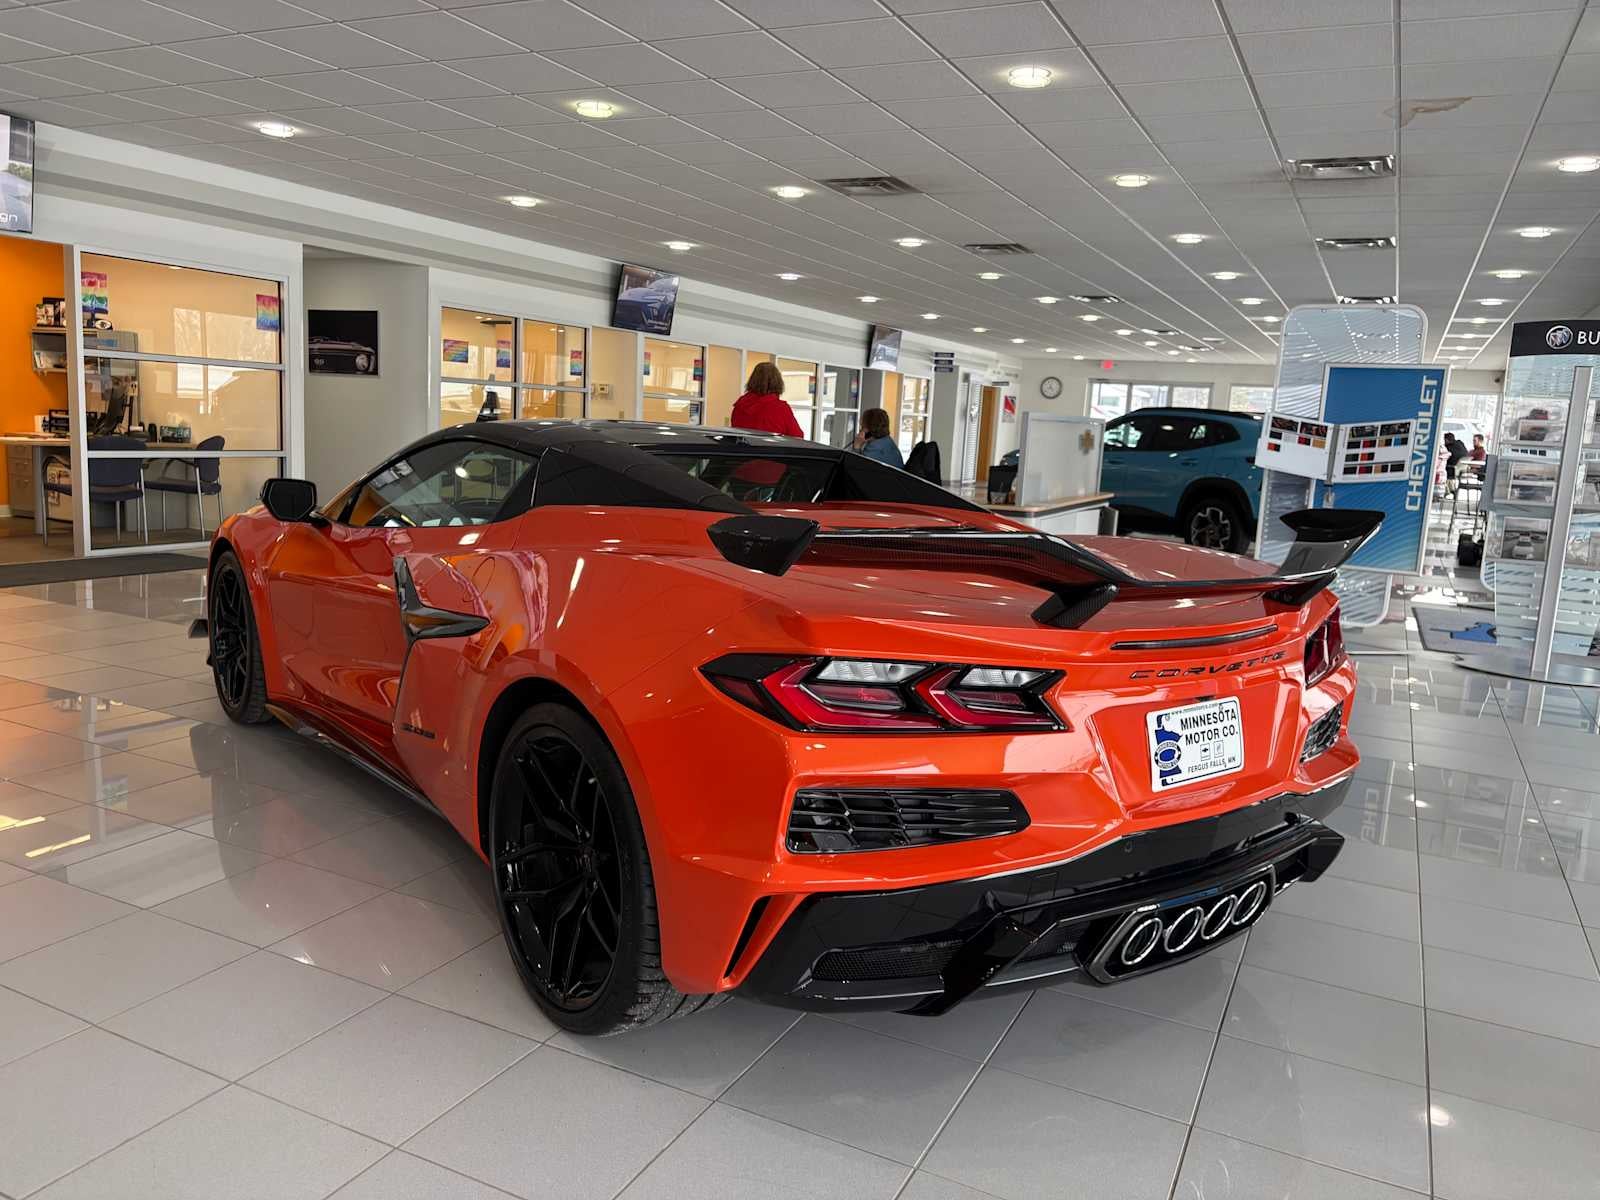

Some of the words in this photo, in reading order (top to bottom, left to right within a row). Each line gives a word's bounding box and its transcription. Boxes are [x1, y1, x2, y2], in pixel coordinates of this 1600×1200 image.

[1405, 375, 1438, 511] CHEVROLET
[1130, 650, 1286, 680] CORVETTE
[1180, 708, 1237, 731] MINNESOTA
[1185, 728, 1220, 746] MOTOR
[1222, 724, 1239, 738] CO.
[1187, 762, 1209, 774] FERGUS
